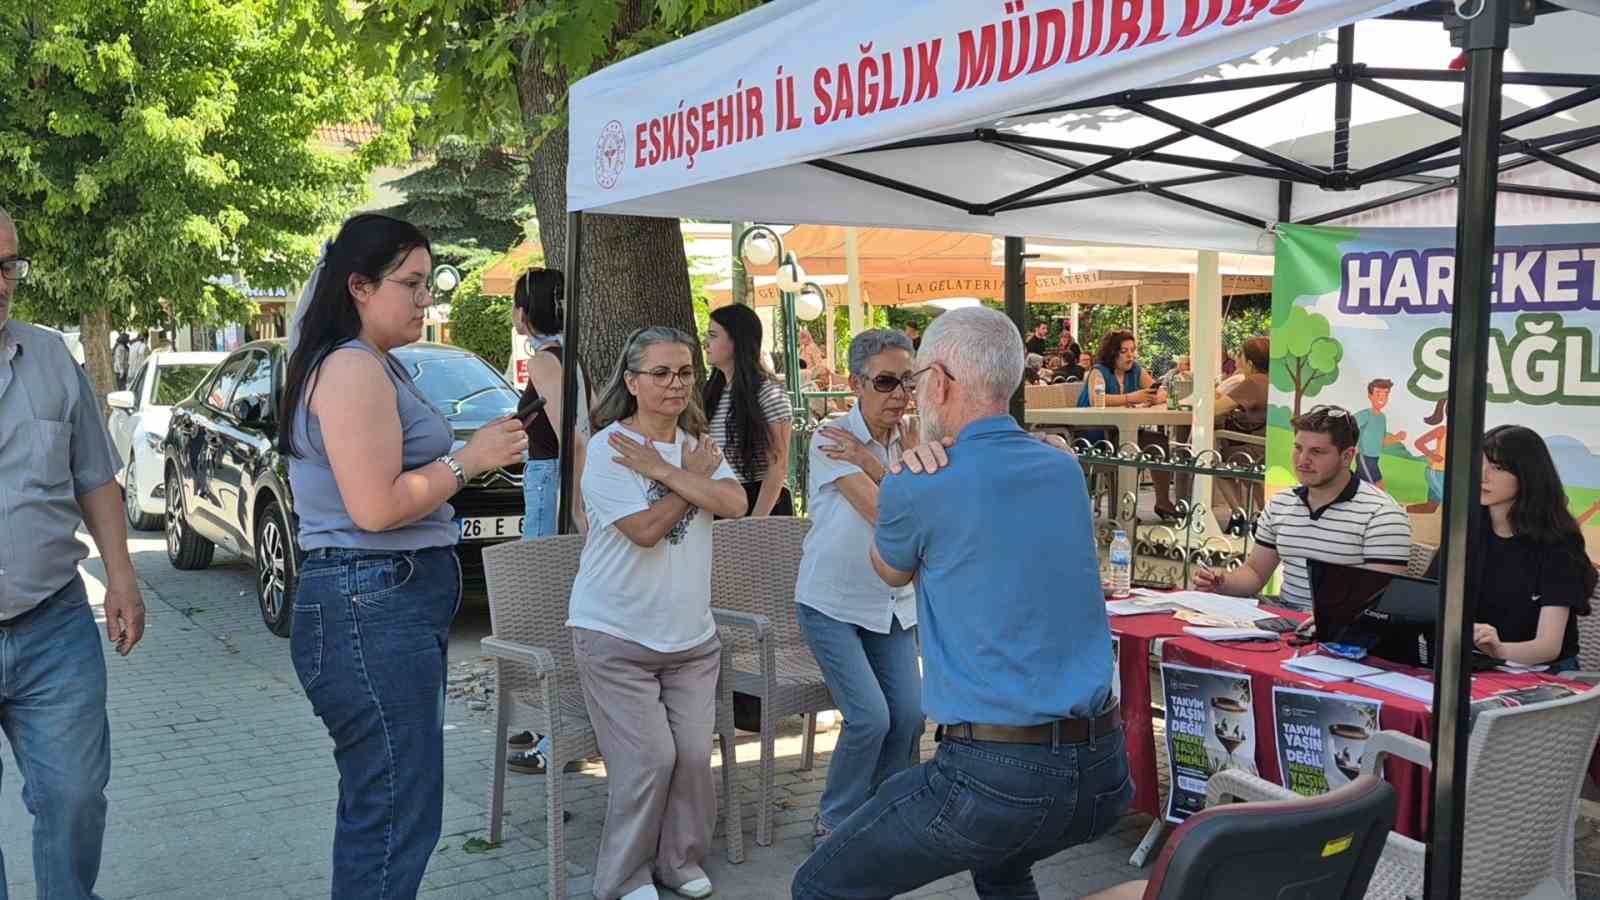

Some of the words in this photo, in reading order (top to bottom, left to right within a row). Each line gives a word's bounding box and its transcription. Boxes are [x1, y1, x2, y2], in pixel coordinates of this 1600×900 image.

[634, 79, 763, 169] ESKİŞEHİR
[775, 65, 802, 132] İL
[813, 39, 940, 125] SAĞLIK
[906, 282, 923, 295] LA
[463, 519, 481, 537] 26
[495, 518, 505, 536] E
